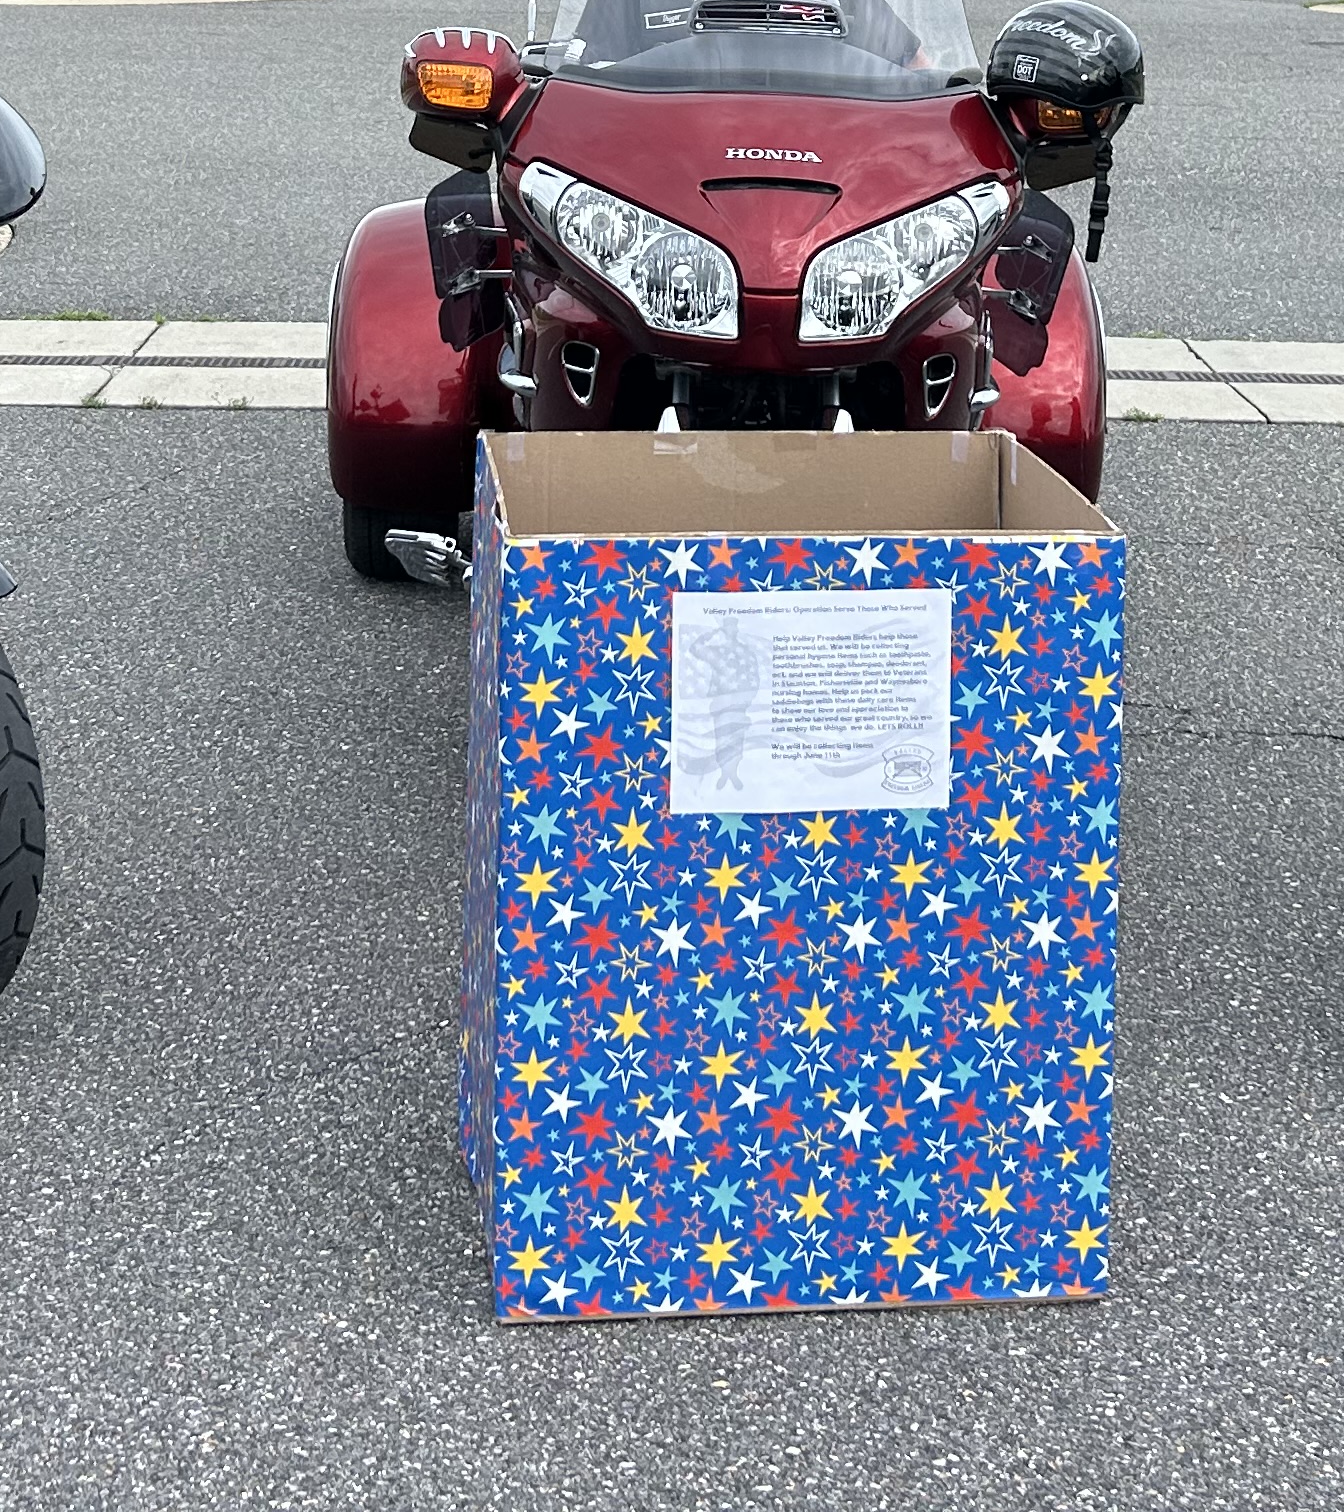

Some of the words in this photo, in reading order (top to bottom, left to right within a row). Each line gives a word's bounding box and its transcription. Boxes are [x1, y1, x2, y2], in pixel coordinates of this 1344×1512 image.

[1017, 64, 1033, 76] DOT
[725, 148, 823, 163] HONDA
[793, 605, 832, 615] Operation
[900, 603, 927, 611] Served
[773, 635, 790, 643] Help
[792, 634, 815, 643] Valley
